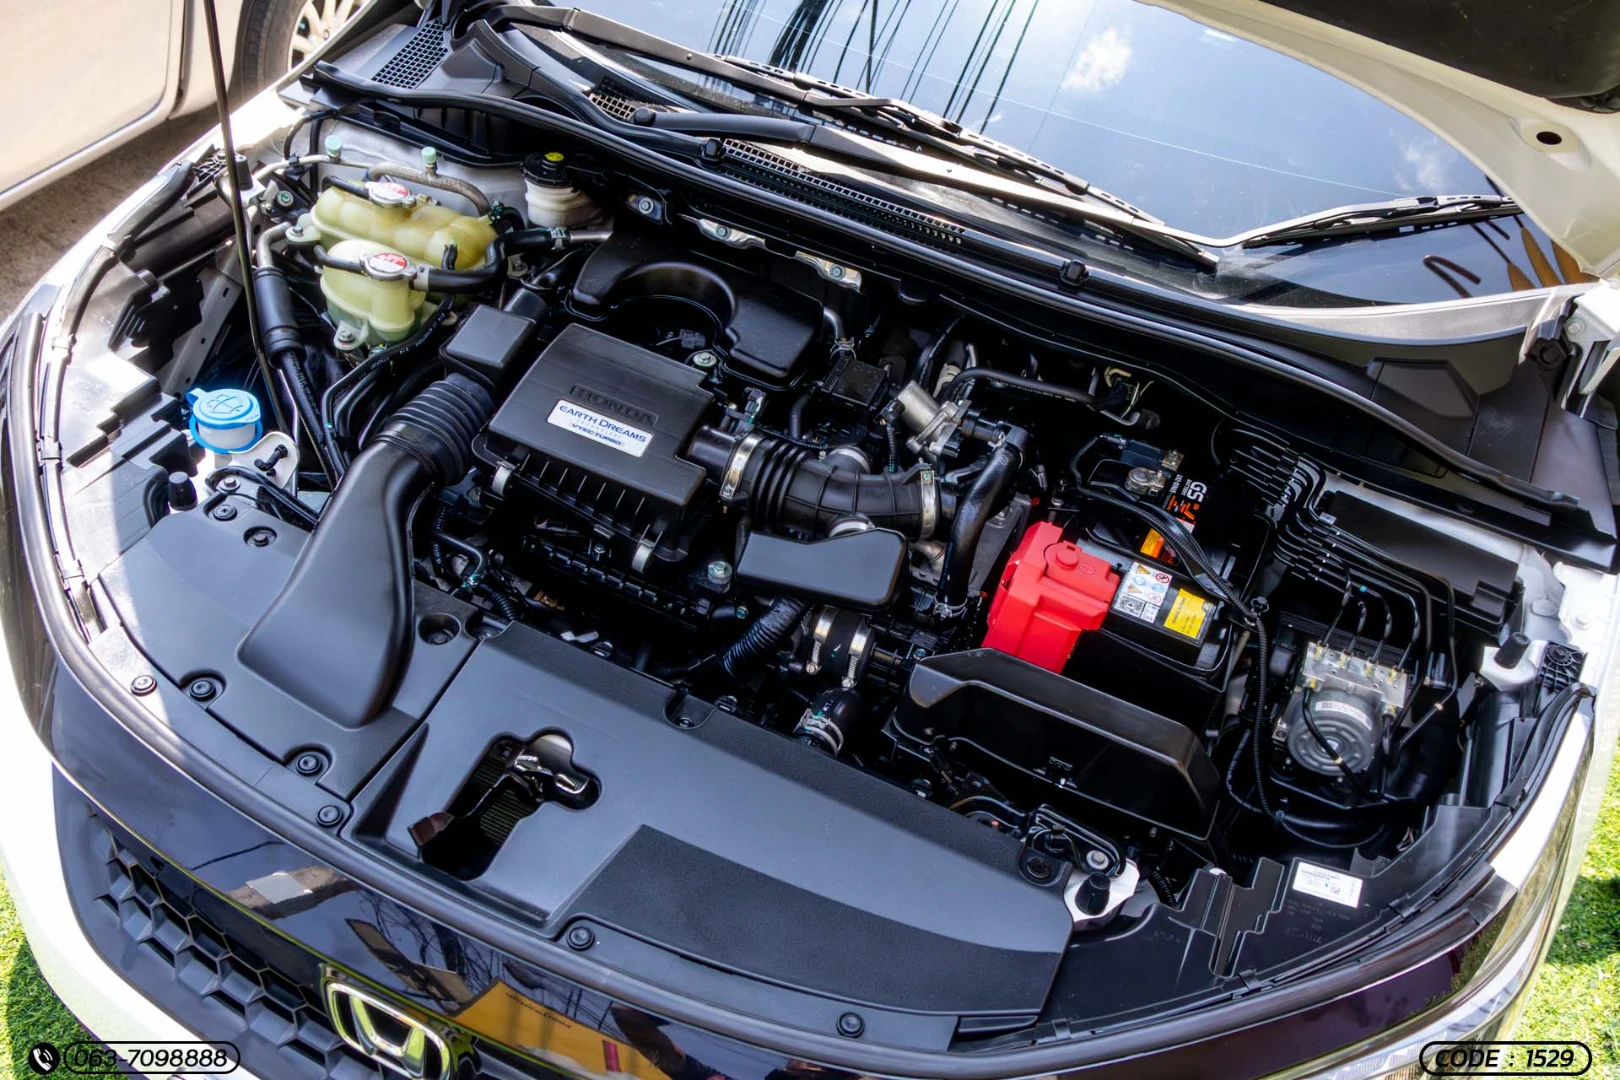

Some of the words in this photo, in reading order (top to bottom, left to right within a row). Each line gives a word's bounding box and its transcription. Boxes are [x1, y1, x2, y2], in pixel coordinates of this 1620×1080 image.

[559, 405, 598, 425] EARTH
[598, 418, 648, 443] DREAMS
[571, 385, 654, 426] HONDA
[1186, 481, 1208, 503] GS
